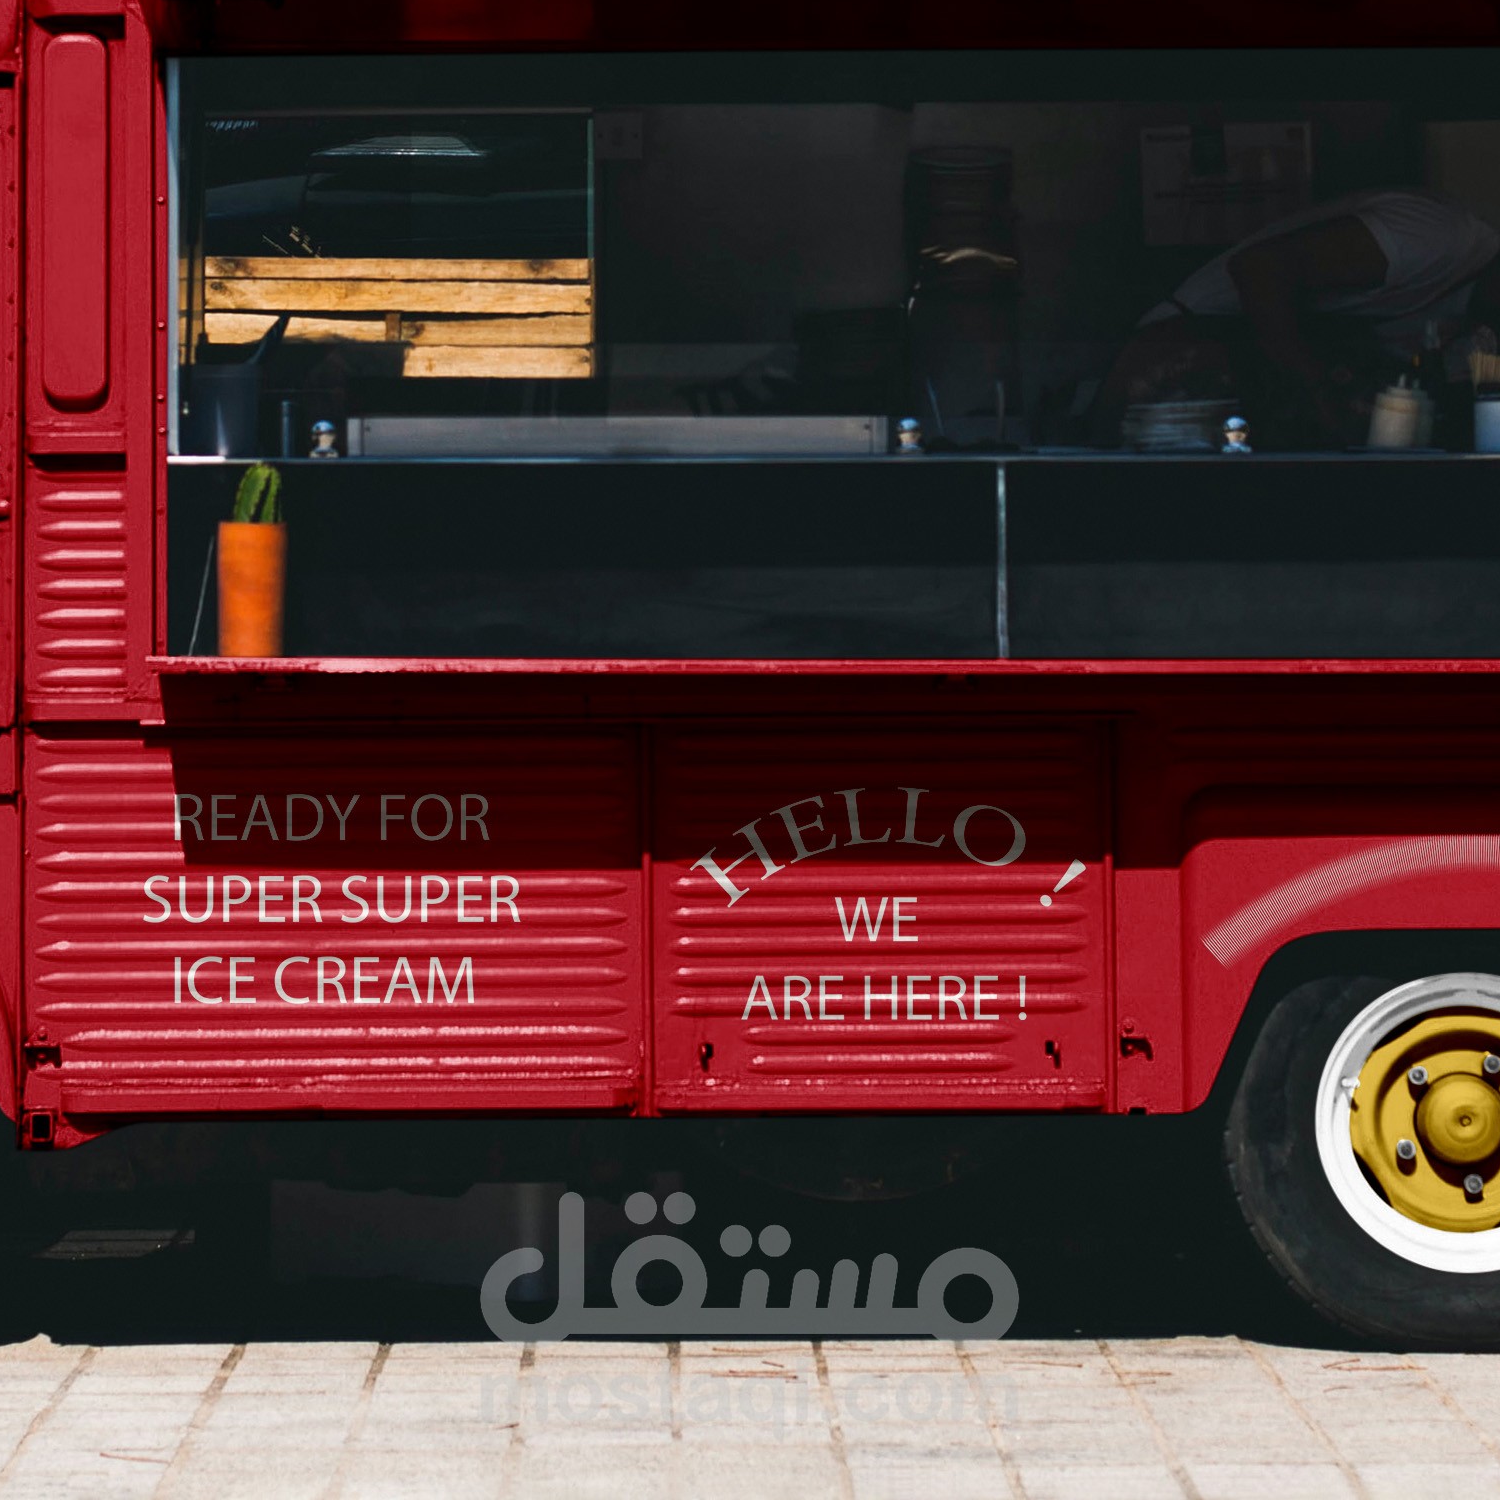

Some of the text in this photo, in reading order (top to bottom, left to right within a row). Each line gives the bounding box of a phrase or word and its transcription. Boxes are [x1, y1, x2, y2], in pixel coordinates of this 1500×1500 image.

[174, 793, 491, 842] READY FOR
[689, 785, 1028, 909] HELLO
[142, 874, 522, 924] SUPER SUPER
[834, 896, 920, 942] WE
[173, 956, 476, 1005] ICE CREAM
[741, 974, 846, 1021] ARE
[863, 974, 1000, 1021] HERE
